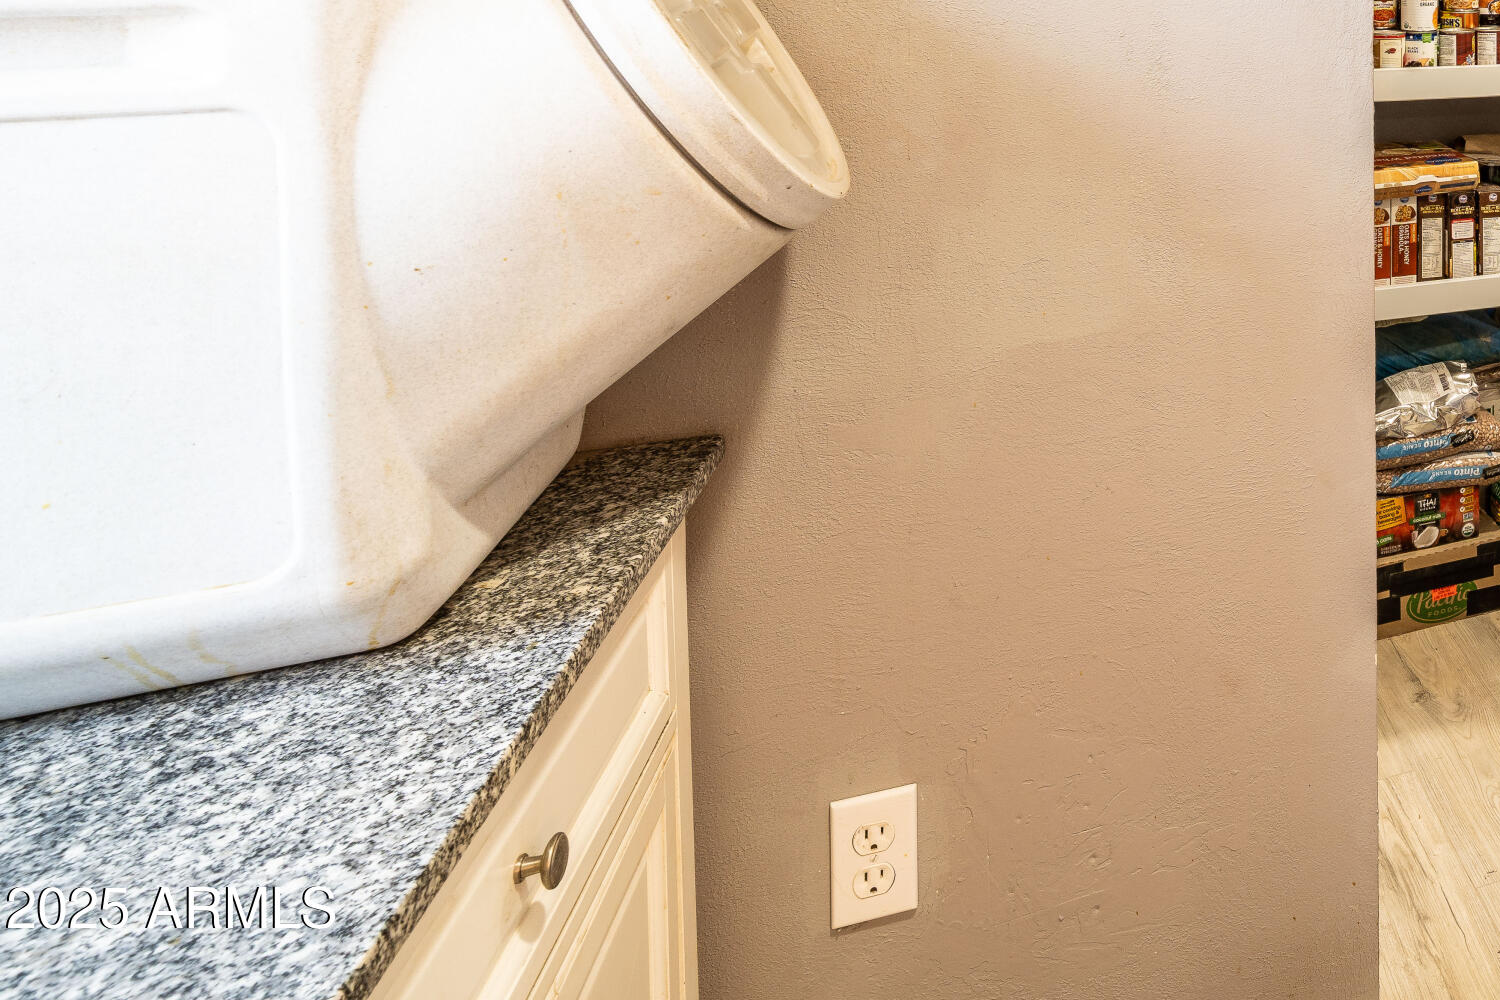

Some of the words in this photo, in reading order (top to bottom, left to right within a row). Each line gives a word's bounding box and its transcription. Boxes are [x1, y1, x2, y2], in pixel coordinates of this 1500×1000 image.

[1423, 438, 1449, 448] Pinto
[1453, 467, 1480, 476] Pinto
[1417, 497, 1437, 509] THAI
[1379, 511, 1395, 520] baking
